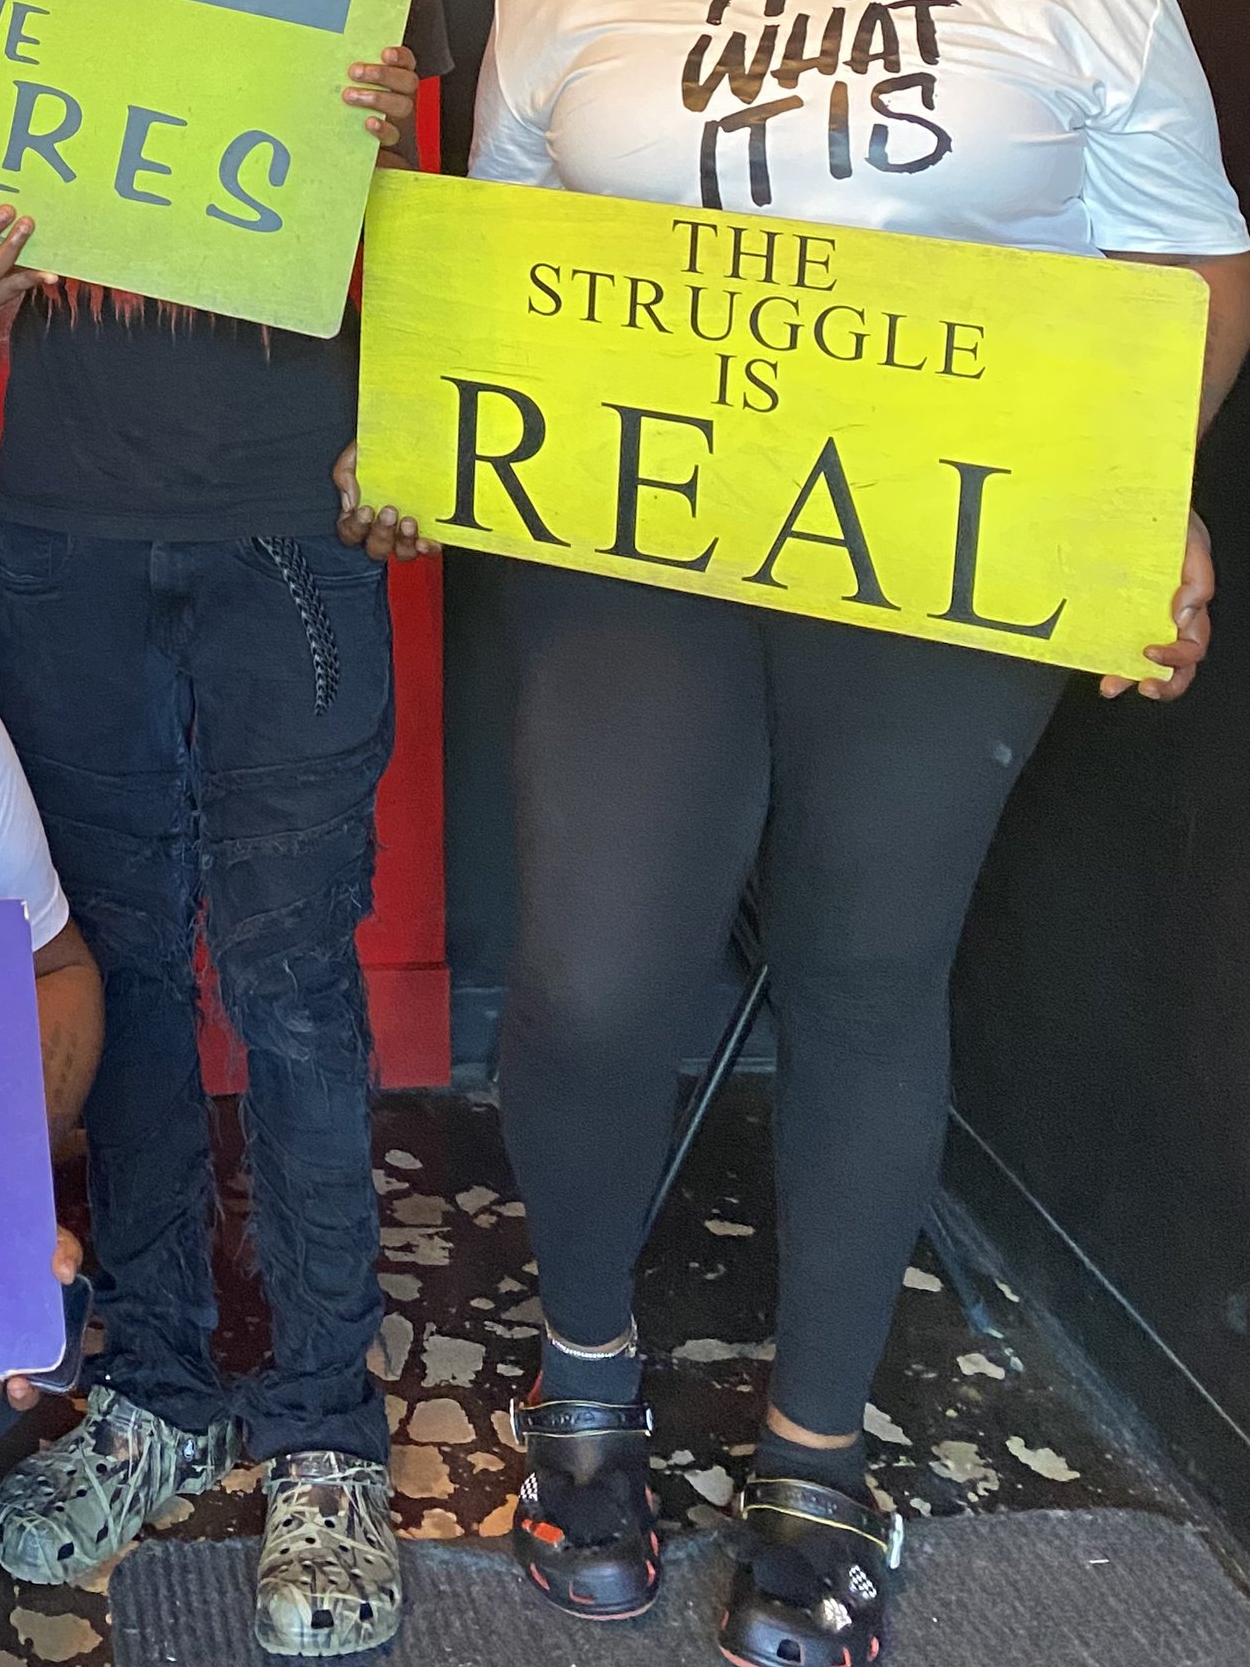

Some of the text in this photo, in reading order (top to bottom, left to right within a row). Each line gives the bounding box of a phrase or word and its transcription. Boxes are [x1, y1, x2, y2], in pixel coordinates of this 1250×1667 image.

[700, 72, 953, 210] IT IS
[671, 219, 838, 292] THE
[527, 262, 986, 380] STRUGGLE
[711, 353, 780, 413] IS
[436, 375, 1067, 641] REAL
